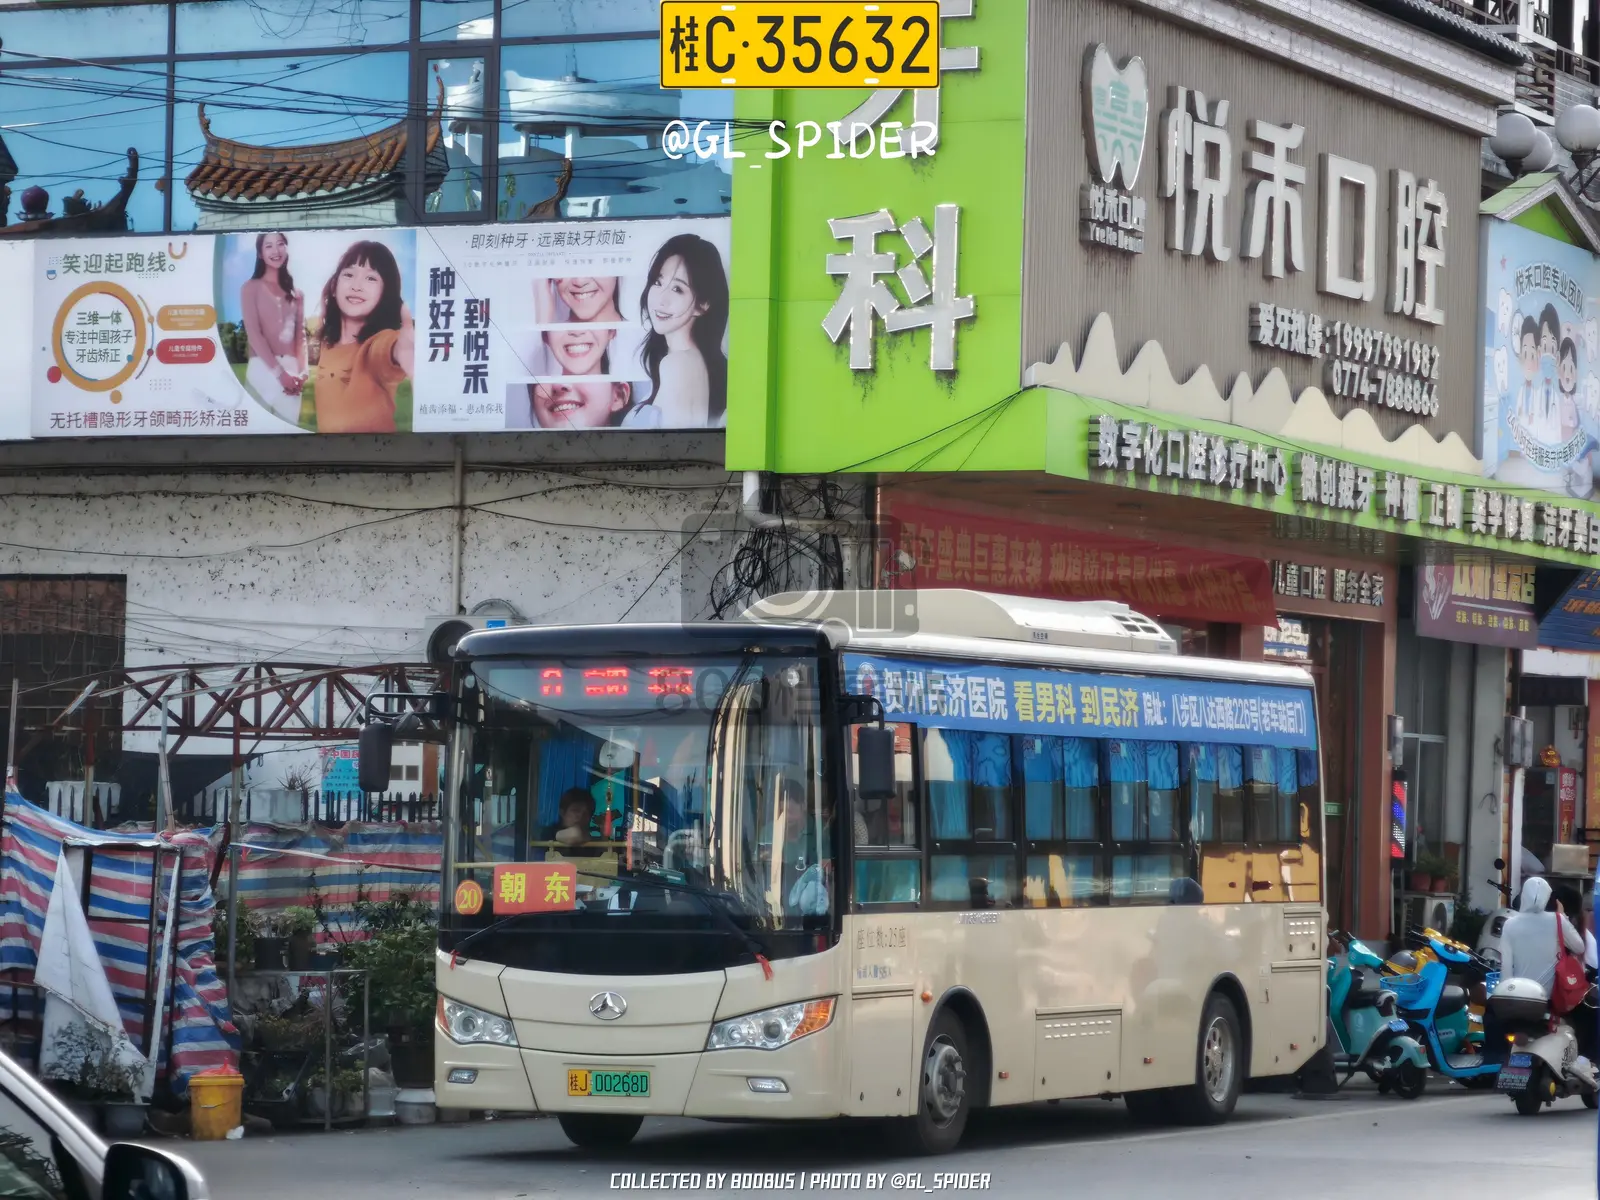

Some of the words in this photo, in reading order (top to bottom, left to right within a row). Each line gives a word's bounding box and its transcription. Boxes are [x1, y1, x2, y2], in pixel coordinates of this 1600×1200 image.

[1157, 85, 1448, 326] 悦禾口腔
[76, 311, 122, 326] 三维一体
[428, 267, 456, 362] 种好牙
[1515, 263, 1584, 319] 悦禾口腔专业团队
[64, 329, 133, 345] 专注中国孩子
[75, 349, 121, 364] 牙齿矫正
[463, 298, 491, 394] 到悦禾
[1332, 358, 1440, 418] 0774-7888866
[50, 410, 249, 429] 无托槽隐形牙颌畸形矫治器
[1096, 414, 1288, 496] 数字化口腔诊疗中心
[882, 667, 1009, 721] 贺州民济医院
[1013, 680, 1077, 725] 看男科
[1079, 685, 1140, 728] 到民济
[459, 888, 478, 909] 20
[499, 871, 571, 904] 朝东
